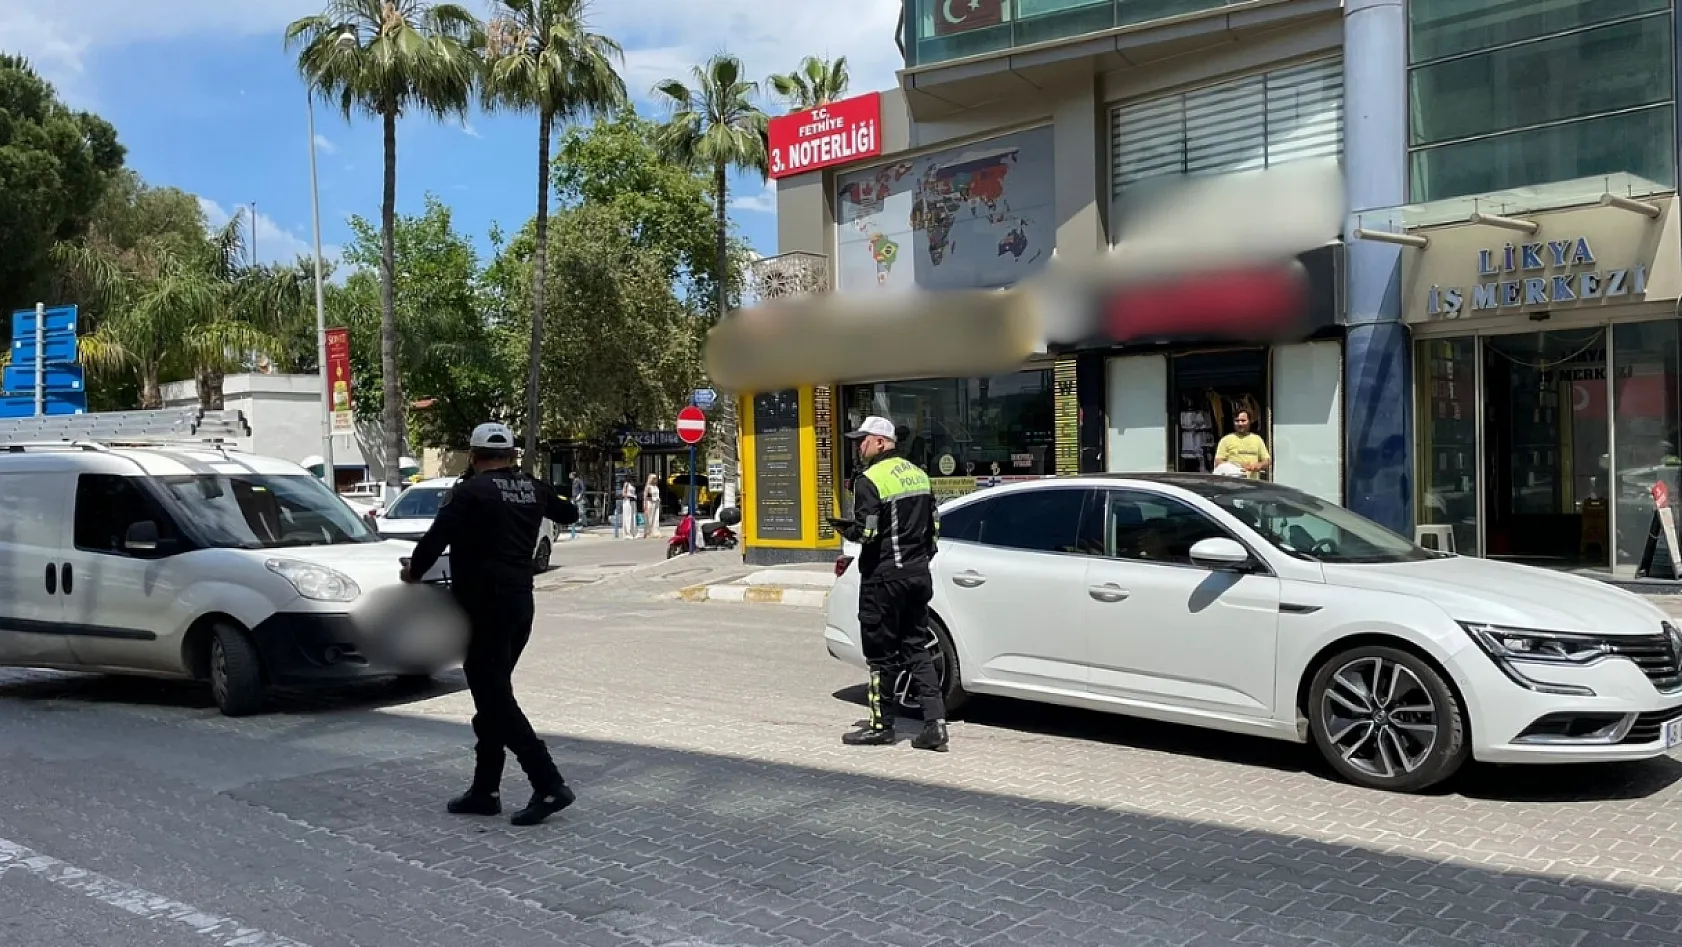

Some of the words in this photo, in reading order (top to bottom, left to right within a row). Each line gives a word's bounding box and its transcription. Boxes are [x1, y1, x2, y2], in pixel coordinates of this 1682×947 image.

[799, 116, 845, 137] FETHİYE
[811, 108, 830, 121] T.C.
[771, 148, 785, 172] 3.
[789, 118, 875, 169] NOTERLİĞİ
[1478, 236, 1596, 275] LİKYA
[1428, 283, 1464, 320] İŞ
[1472, 261, 1648, 310] MERKEZİ
